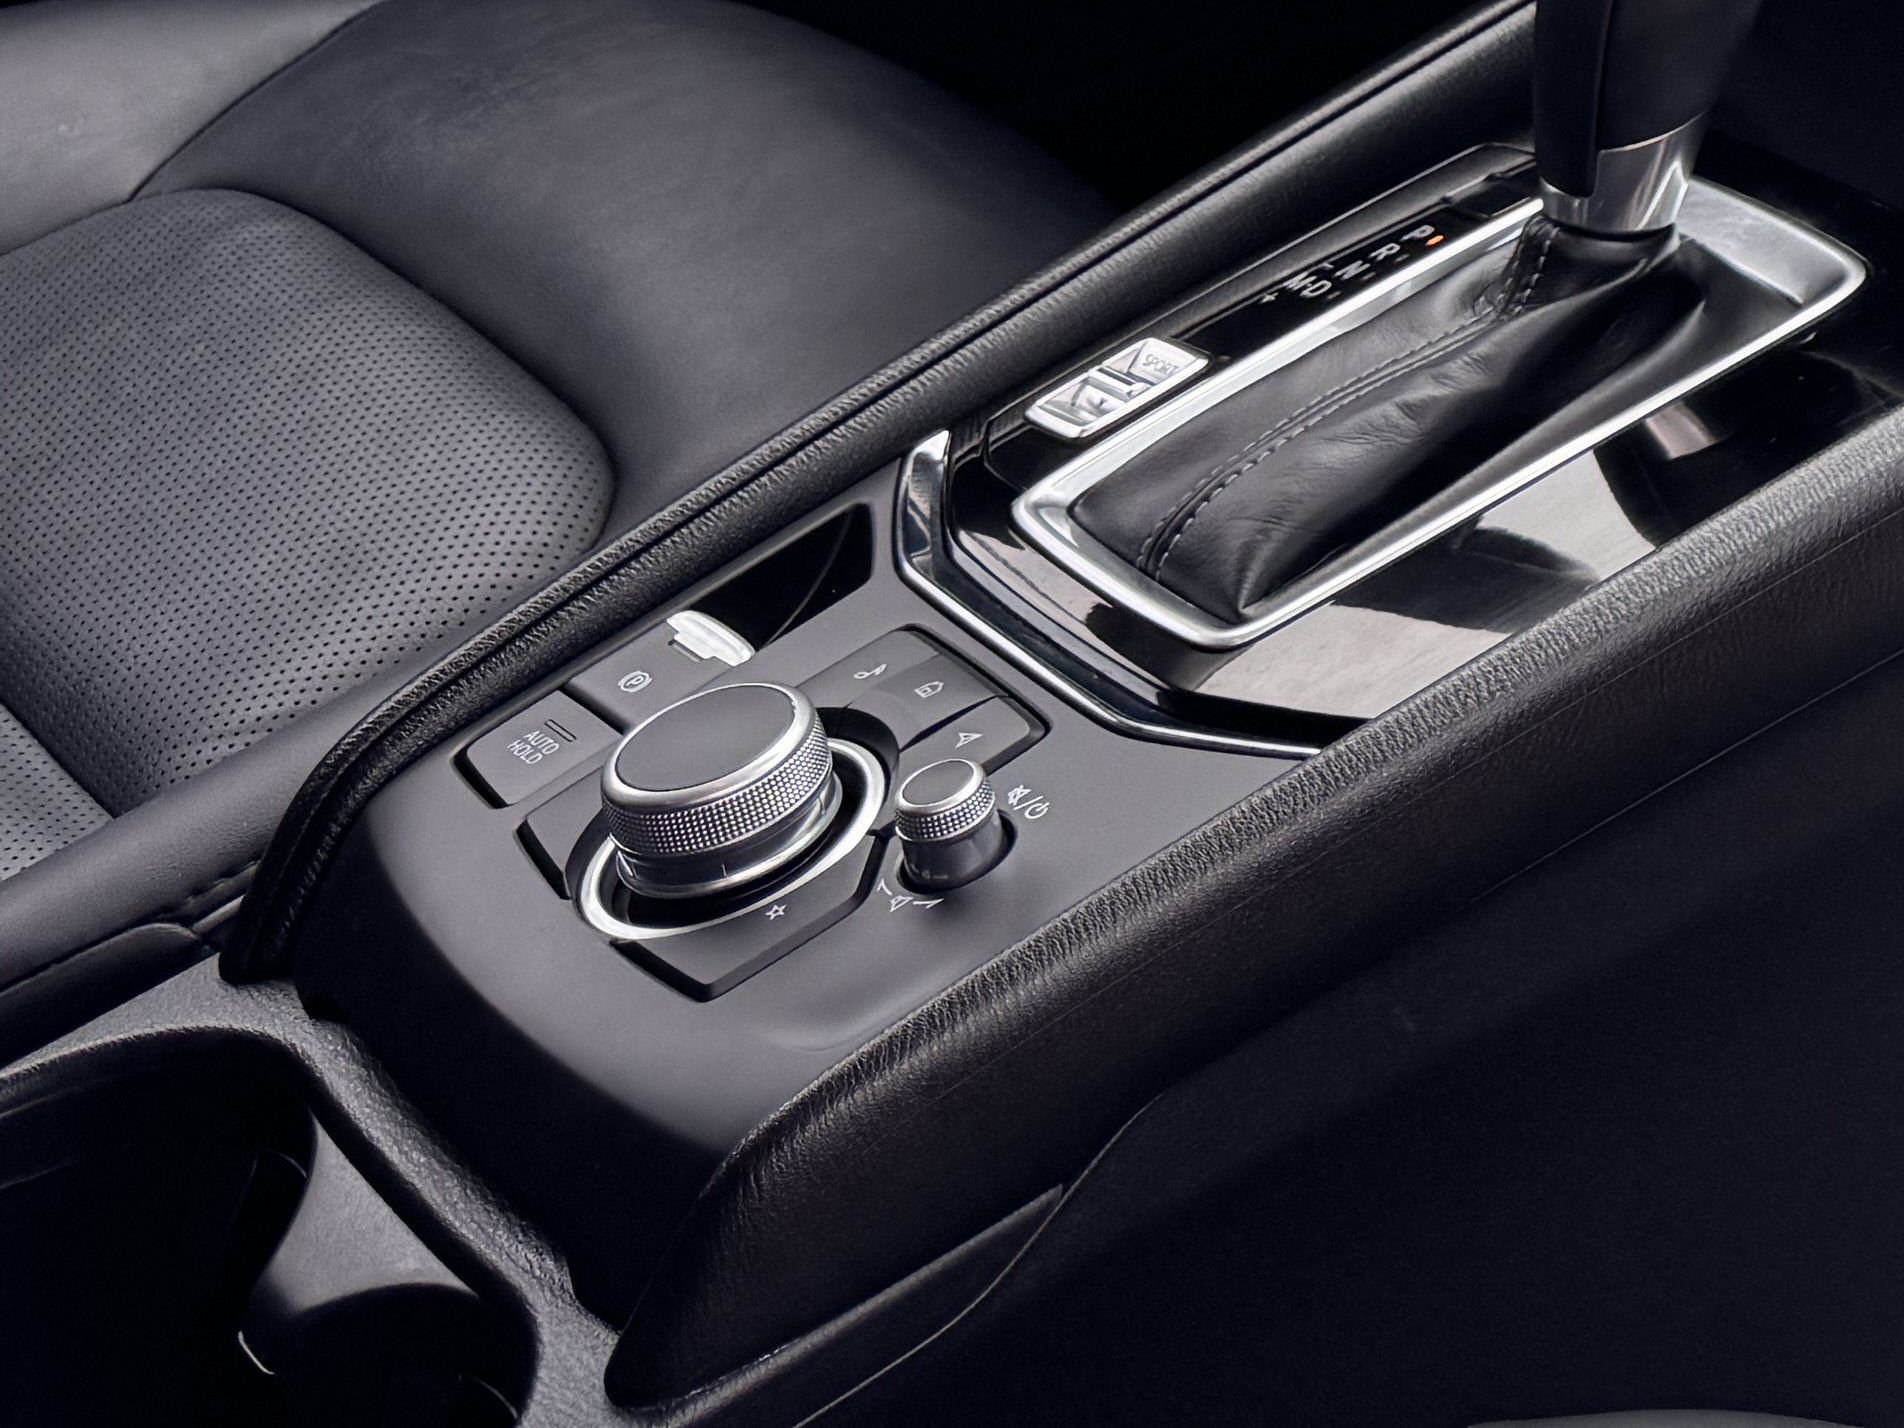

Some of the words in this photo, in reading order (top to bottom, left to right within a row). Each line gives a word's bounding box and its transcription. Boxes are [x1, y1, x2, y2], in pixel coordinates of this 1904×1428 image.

[1141, 353, 1183, 378] SPORT
[507, 739, 543, 764] HOLD
[524, 730, 560, 755] AUTO
